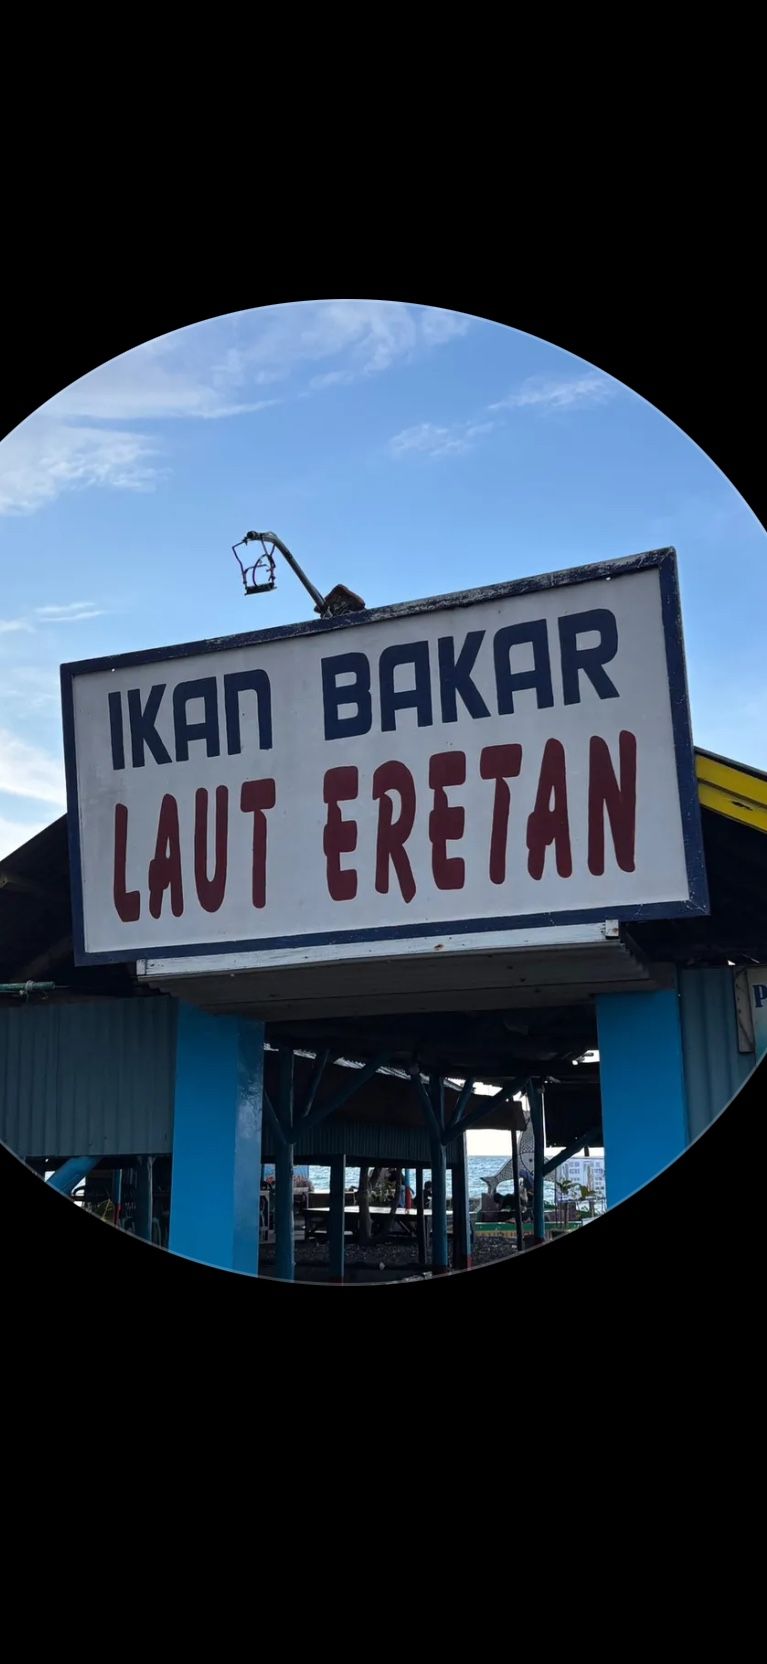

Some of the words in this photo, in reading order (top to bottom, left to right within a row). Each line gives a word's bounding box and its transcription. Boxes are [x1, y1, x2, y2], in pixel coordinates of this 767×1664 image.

[108, 669, 273, 771] IKAN
[321, 608, 620, 741] BAKAR
[113, 778, 276, 922] LAUT
[323, 730, 637, 904] ERETAN
